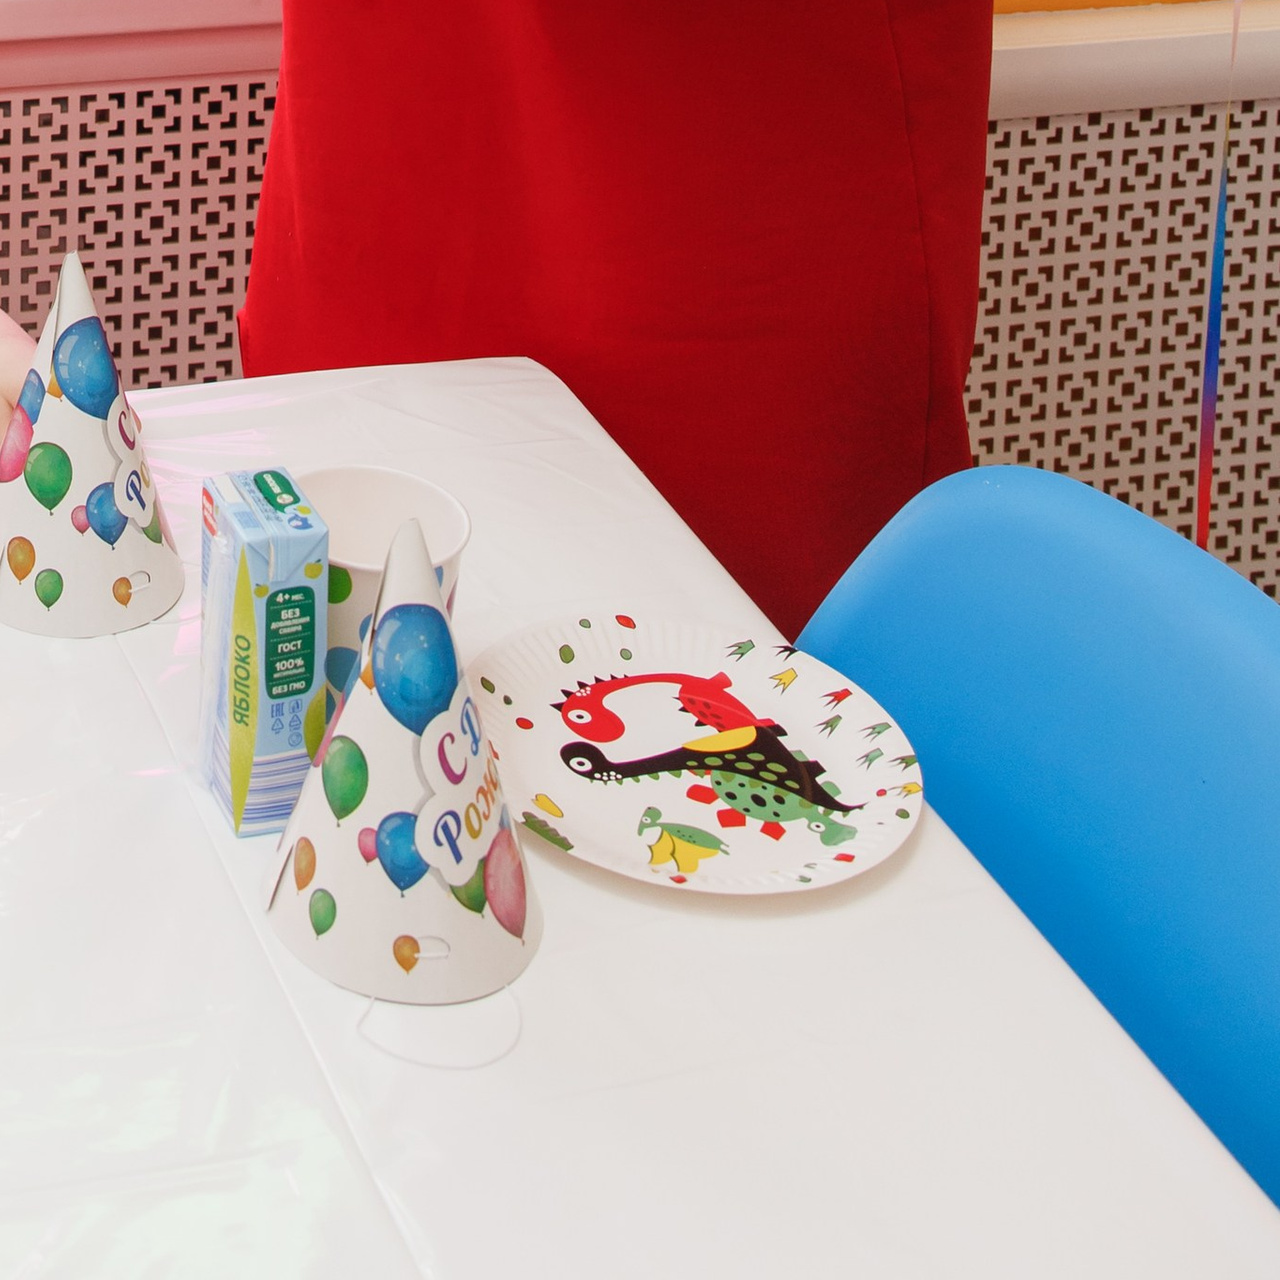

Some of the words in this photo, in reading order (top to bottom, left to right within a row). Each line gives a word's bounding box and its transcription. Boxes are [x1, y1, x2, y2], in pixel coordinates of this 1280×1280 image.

[281, 608, 300, 620] БЕЗ
[277, 640, 302, 653] ГОСТ
[275, 657, 305, 671] 100%
[233, 634, 251, 727] ЯБЛОКО
[271, 683, 288, 695] БЕЗ
[288, 680, 307, 692] ГМО
[438, 732, 468, 786] С
